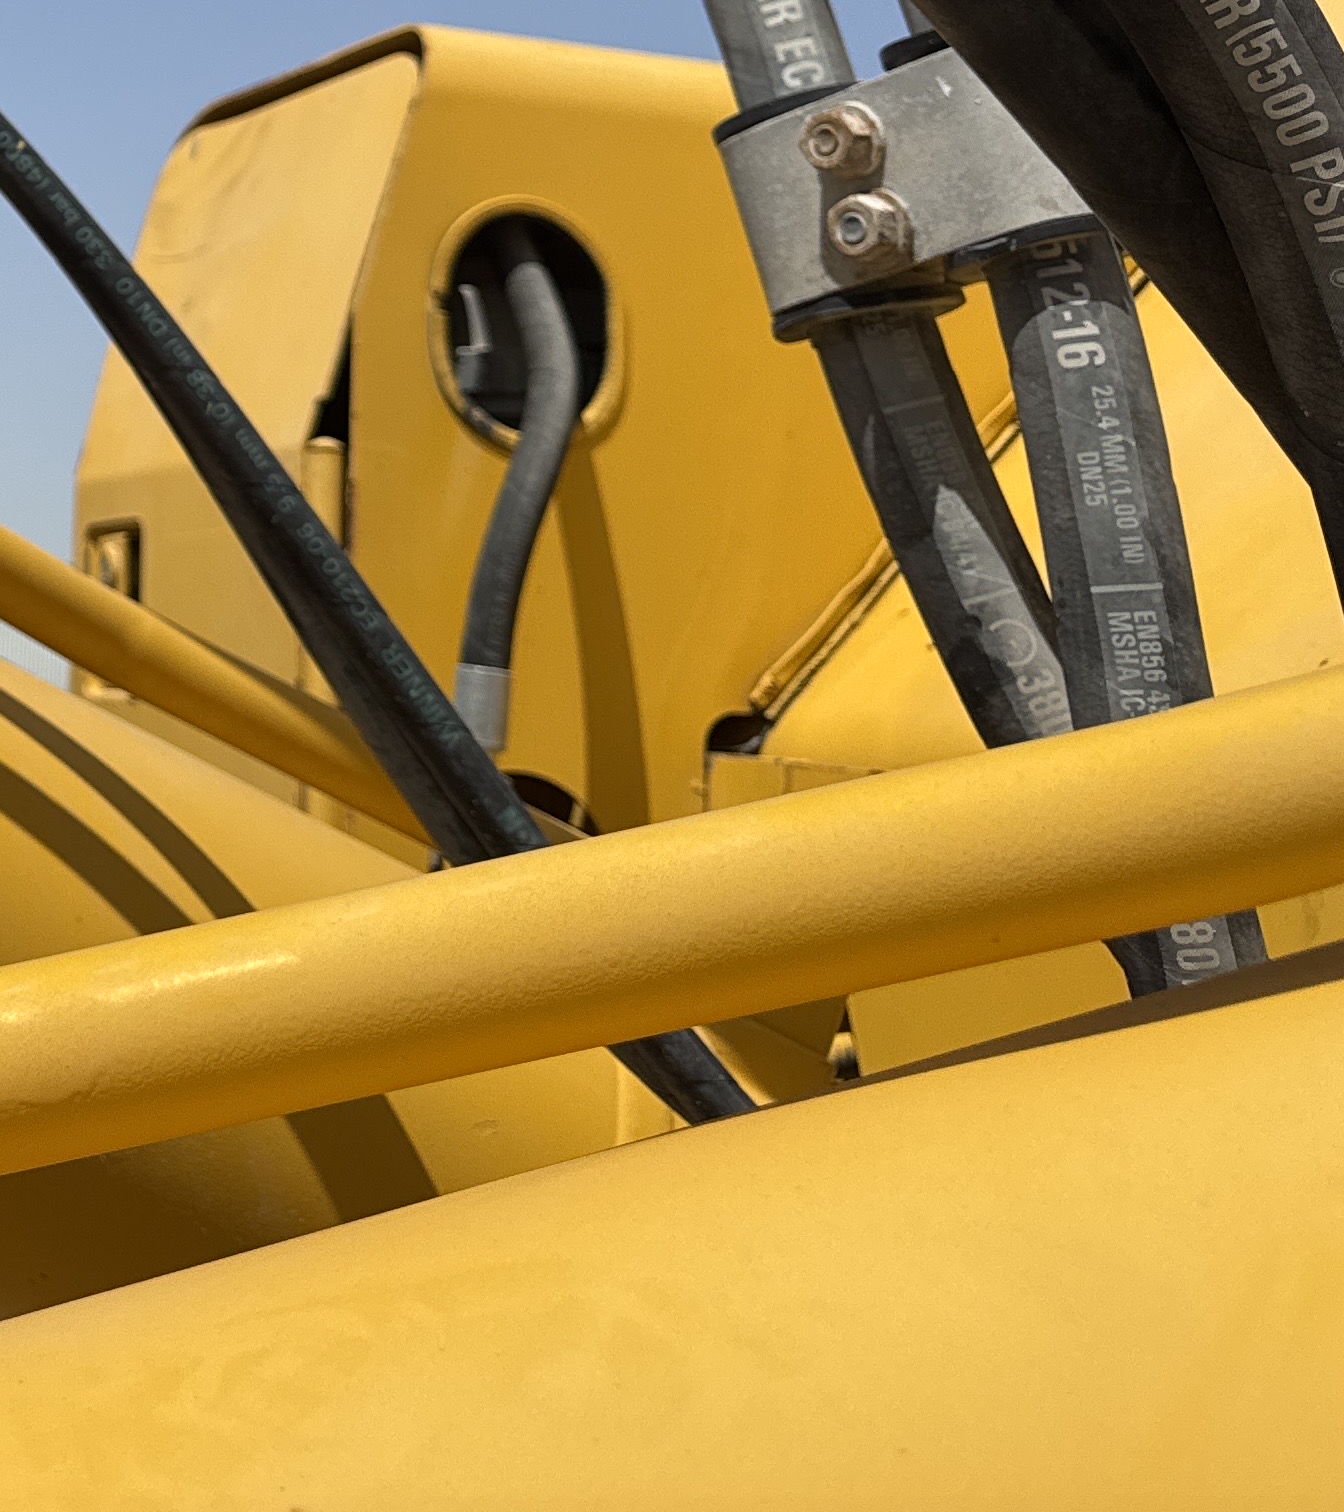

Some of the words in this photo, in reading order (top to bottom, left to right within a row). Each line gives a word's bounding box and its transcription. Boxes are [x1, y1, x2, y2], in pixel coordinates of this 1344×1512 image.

[116, 276, 169, 337] DN10
[1091, 385, 1120, 429] 25.4
[1077, 452, 1109, 506] DN25
[1101, 434, 1129, 479] MM
[1108, 483, 1139, 529] (1.00
[1120, 533, 1145, 564] IN)
[1107, 612, 1141, 686] MSHA
[1133, 610, 1168, 685] EN856
[381, 642, 462, 749] WINNER
